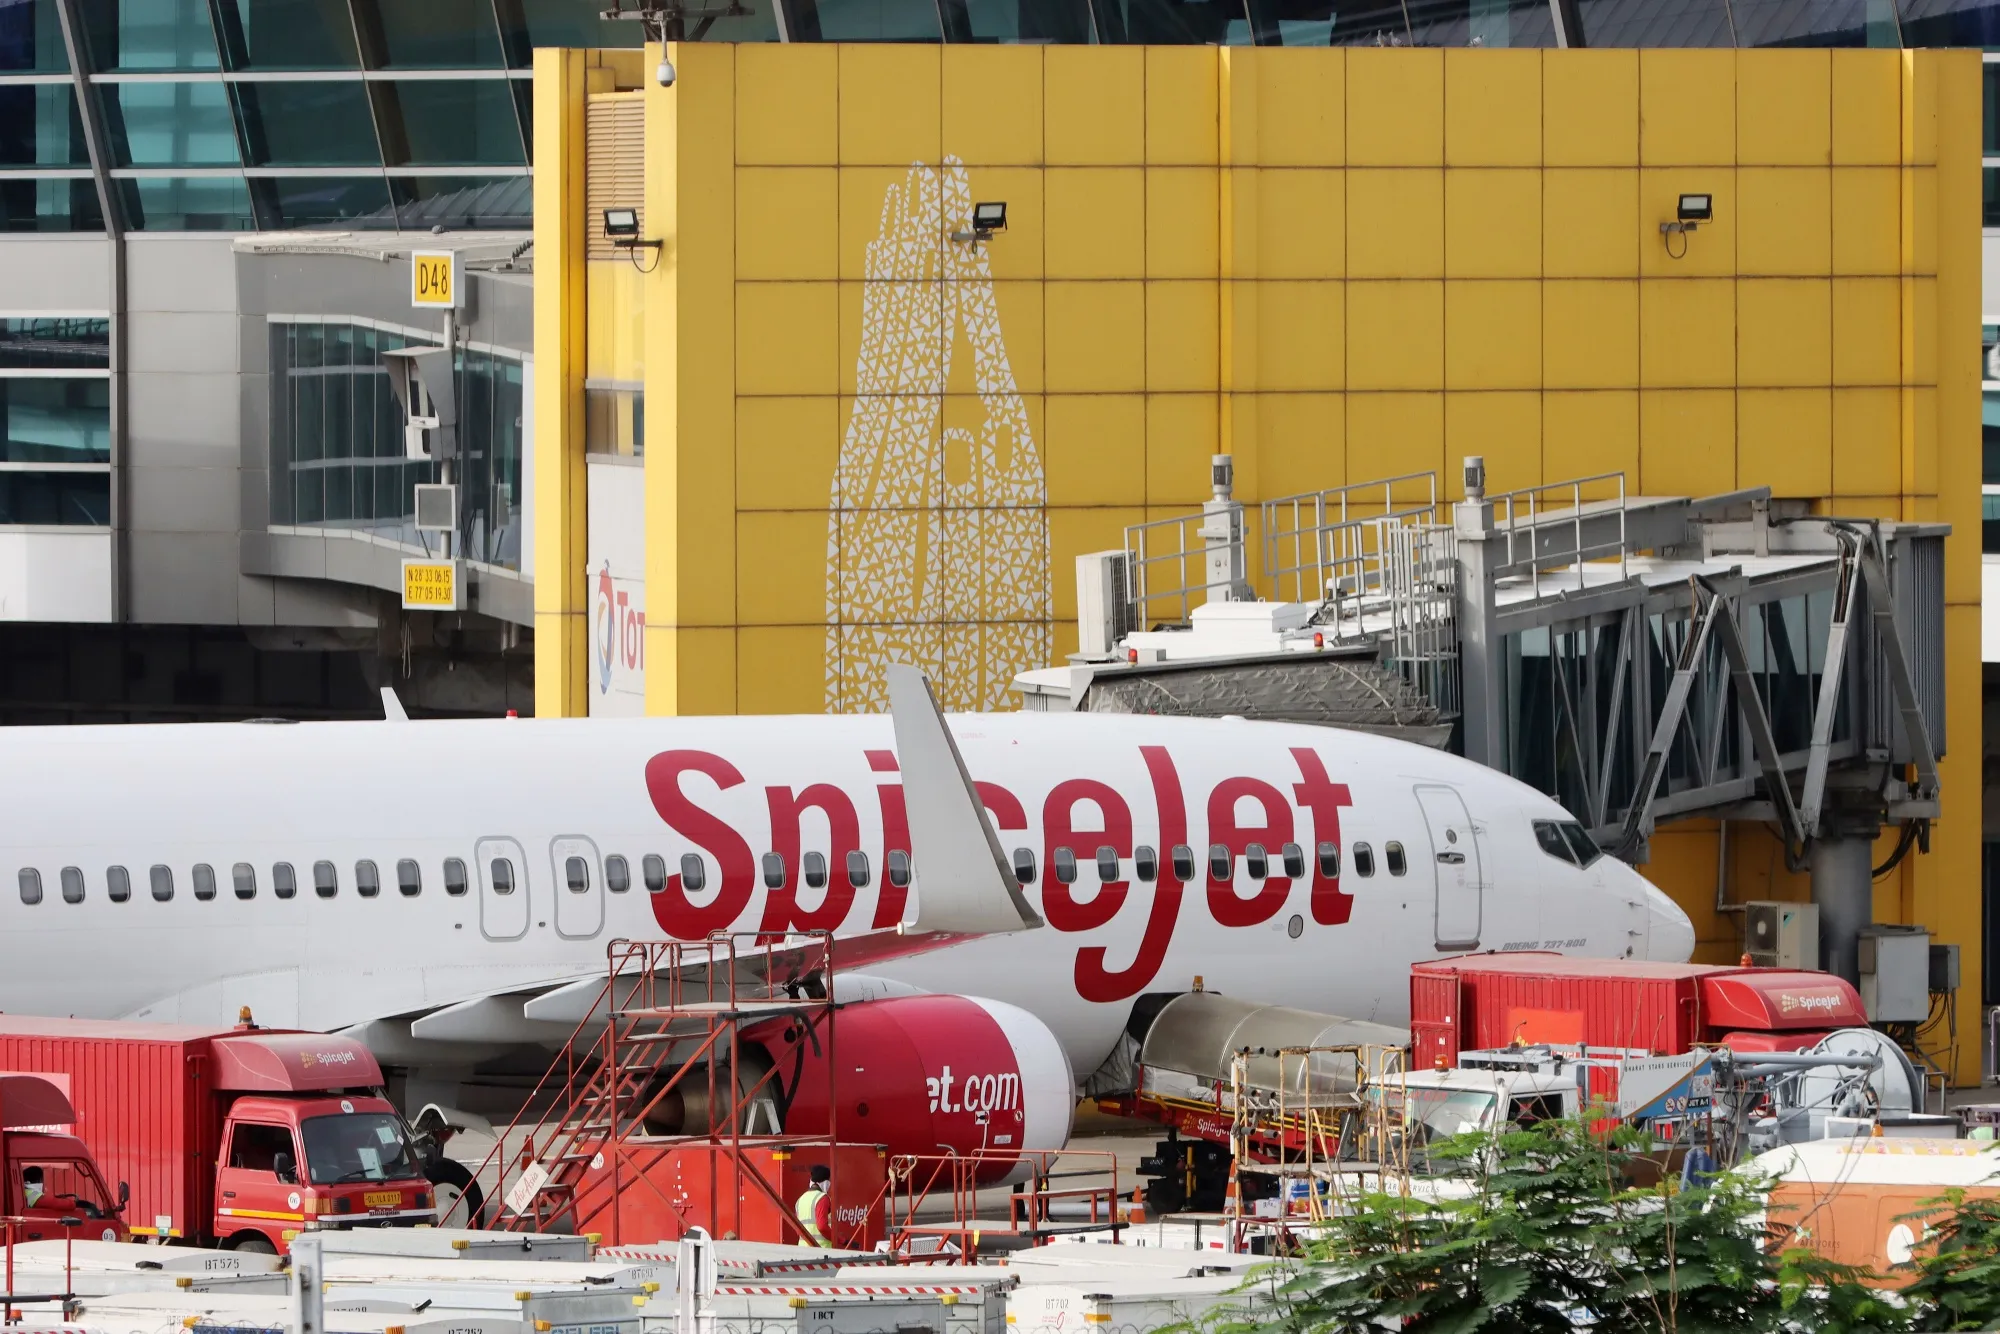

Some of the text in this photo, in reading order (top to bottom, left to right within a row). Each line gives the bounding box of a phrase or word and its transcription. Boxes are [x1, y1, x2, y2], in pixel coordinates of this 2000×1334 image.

[420, 262, 448, 295] D48
[1502, 938, 1587, 951] BOEING 737-800
[1799, 995, 1841, 1011] SpiceJet
[316, 1050, 356, 1067] SpiceJet
